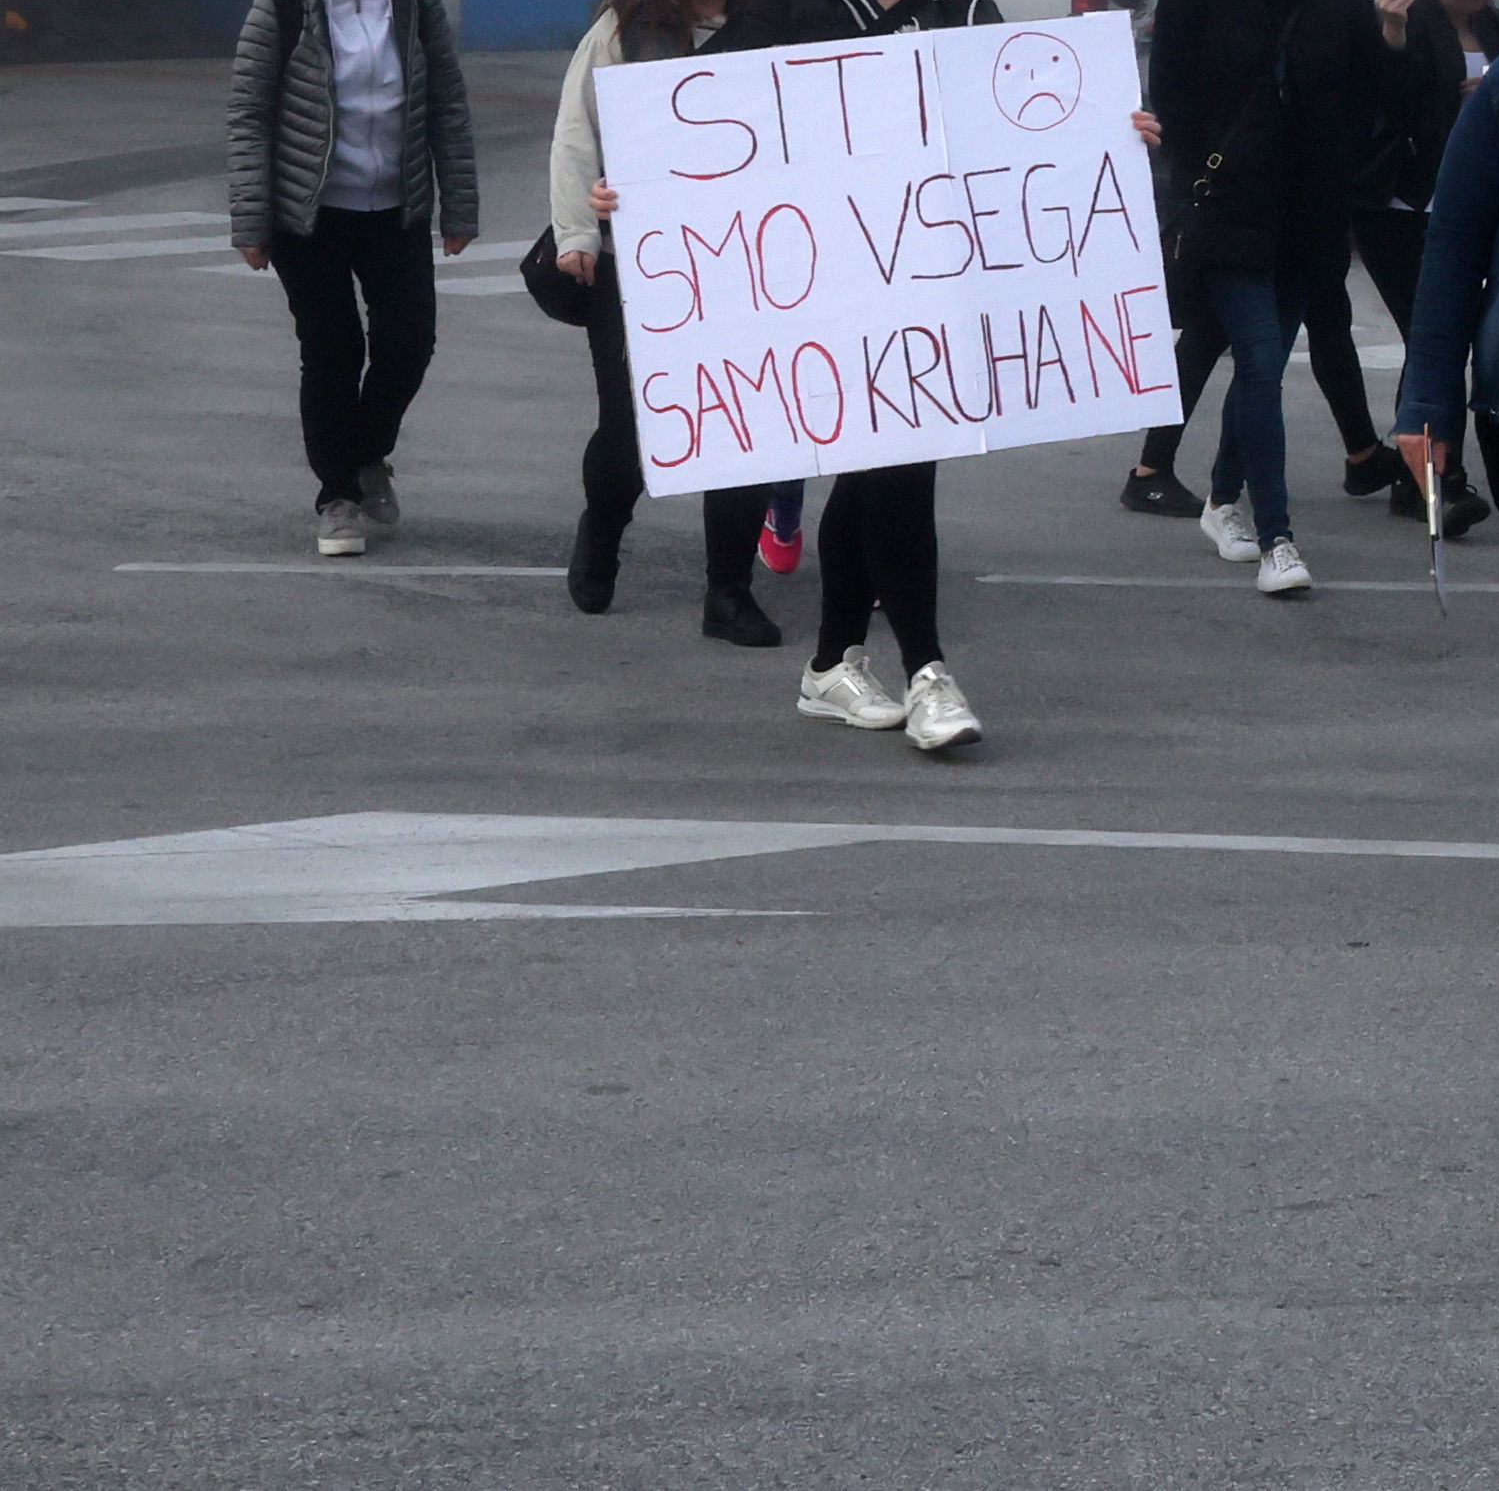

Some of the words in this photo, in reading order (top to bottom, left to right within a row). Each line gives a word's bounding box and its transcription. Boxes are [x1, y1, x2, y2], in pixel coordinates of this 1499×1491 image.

[669, 49, 929, 180] SITI
[636, 203, 817, 332] SMO
[847, 151, 1140, 285] VSEGA
[642, 341, 845, 468] SAMO
[862, 304, 1076, 433] KRUHA
[1080, 285, 1173, 399] NE
